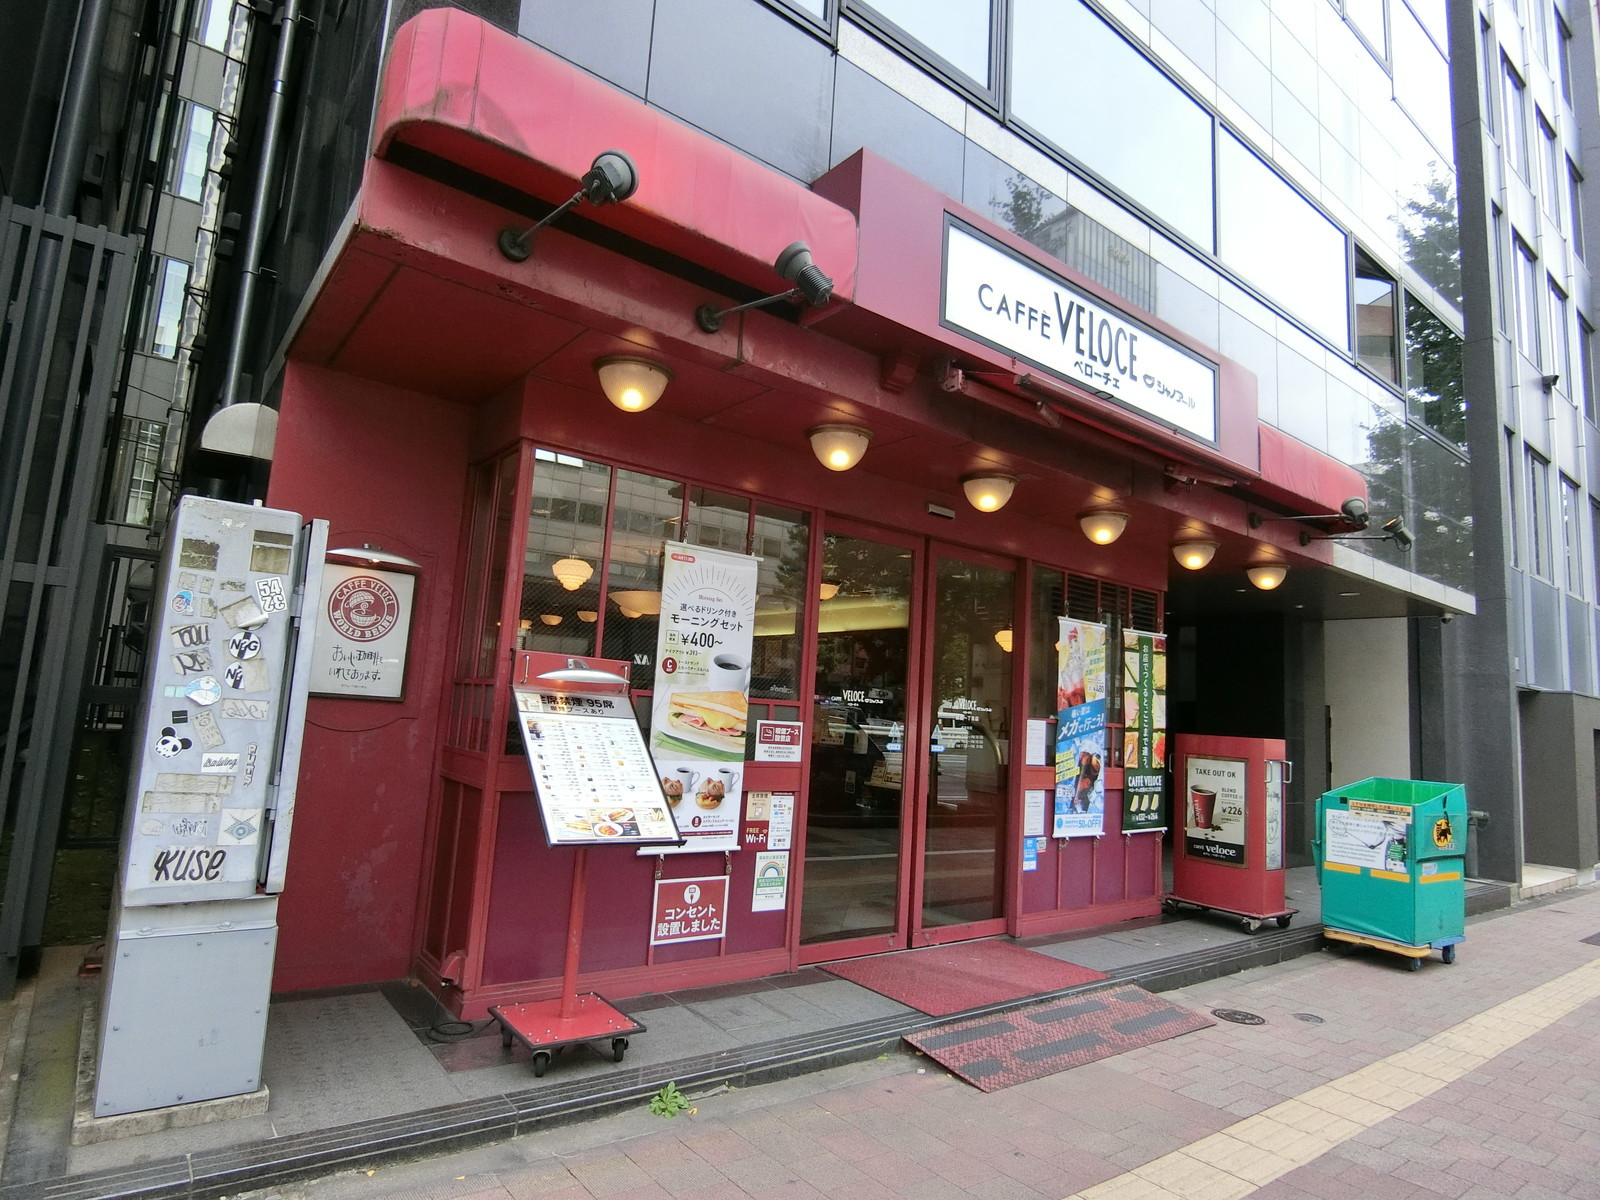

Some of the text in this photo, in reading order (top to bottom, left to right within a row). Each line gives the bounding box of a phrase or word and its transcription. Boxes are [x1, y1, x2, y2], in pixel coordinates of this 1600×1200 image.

[1053, 291, 1138, 381] VELOCE
[1073, 360, 1196, 409] ベローチェ シャノアール
[257, 579, 282, 597] 54
[371, 581, 395, 605] VELOCE
[680, 603, 737, 618] 選べるドリンク付き
[333, 610, 393, 638] WORLD BEANS
[670, 613, 743, 632] モーニングセット
[667, 660, 673, 668] C
[329, 667, 381, 682] いれております。
[842, 690, 865, 703] VELOCE
[1195, 768, 1210, 776] TAKE
[1144, 775, 1162, 786] VELOCE
[1221, 806, 1242, 816] ¥226
[1205, 844, 1237, 857] veloce
[664, 904, 716, 920] コンセント
[657, 918, 721, 937] 設置しました
